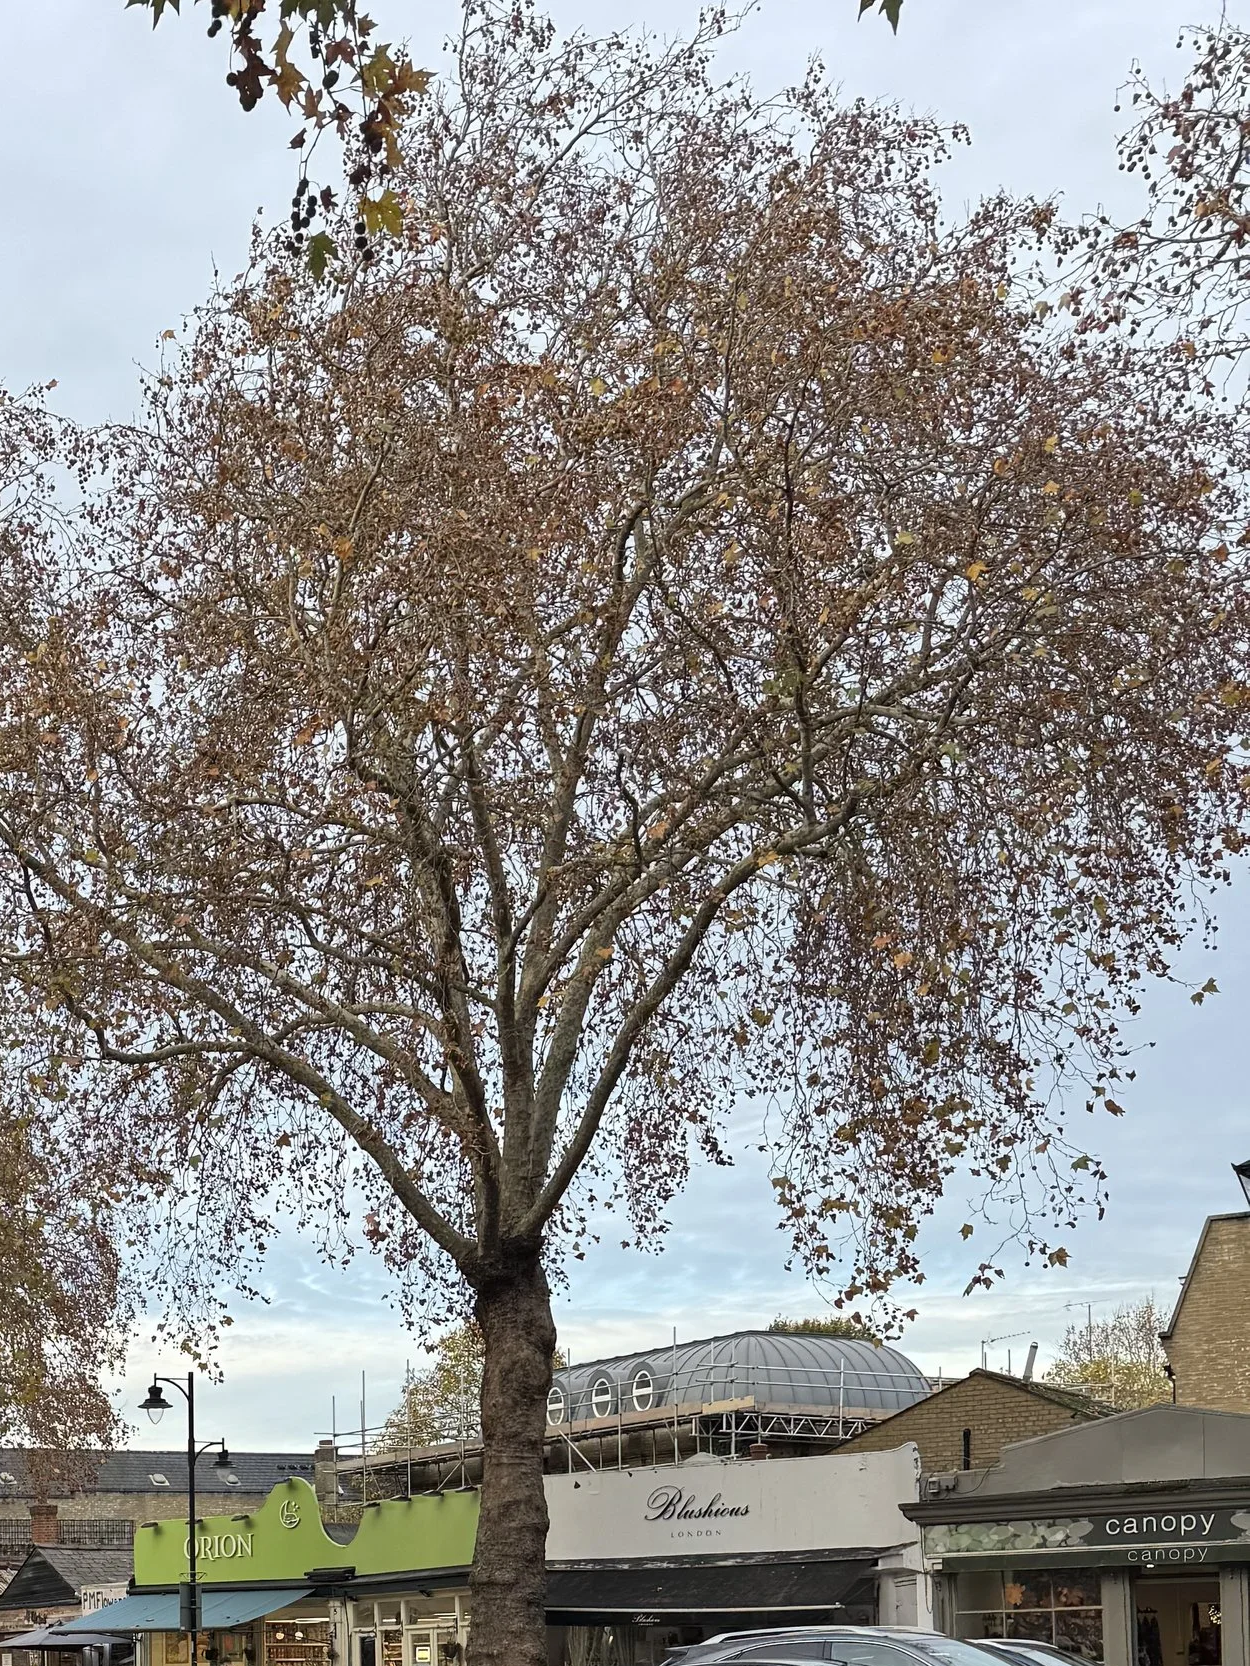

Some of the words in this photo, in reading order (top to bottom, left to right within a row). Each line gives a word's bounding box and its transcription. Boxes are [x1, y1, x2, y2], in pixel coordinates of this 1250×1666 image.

[645, 1485, 749, 1521] Blushious
[670, 1530, 721, 1538] LONDON
[1105, 1513, 1215, 1536] canopy
[184, 1533, 253, 1561] ORION
[1127, 1547, 1208, 1562] canopy
